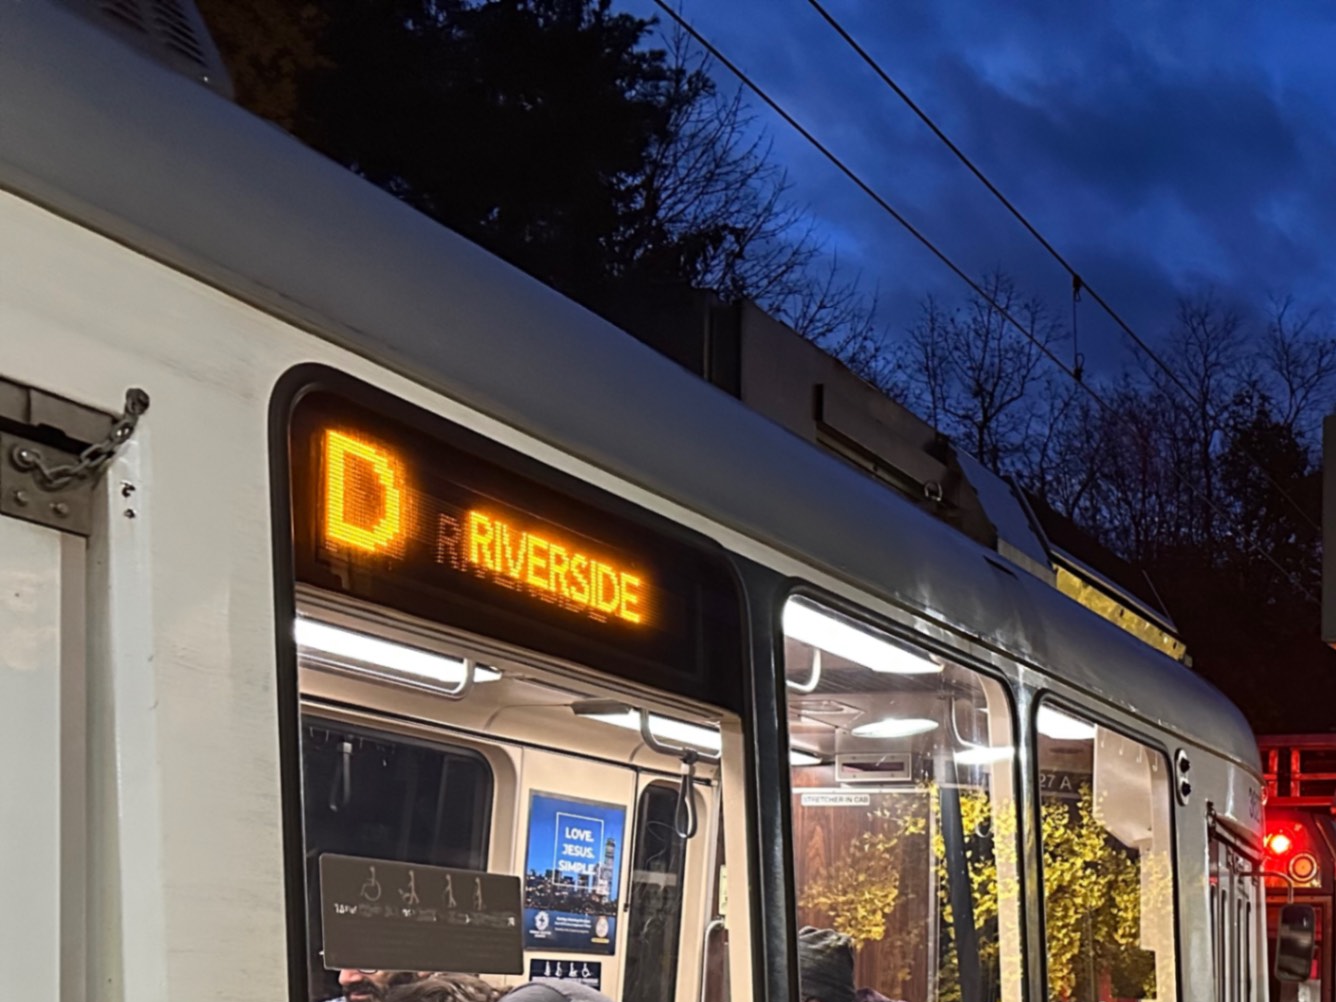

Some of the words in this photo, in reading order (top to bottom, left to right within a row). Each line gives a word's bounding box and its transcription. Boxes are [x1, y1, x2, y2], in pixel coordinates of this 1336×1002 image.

[325, 429, 402, 552] D
[468, 510, 641, 624] RIVERSIDE
[565, 827, 595, 843] LOVE.
[562, 844, 595, 859] JESUS.
